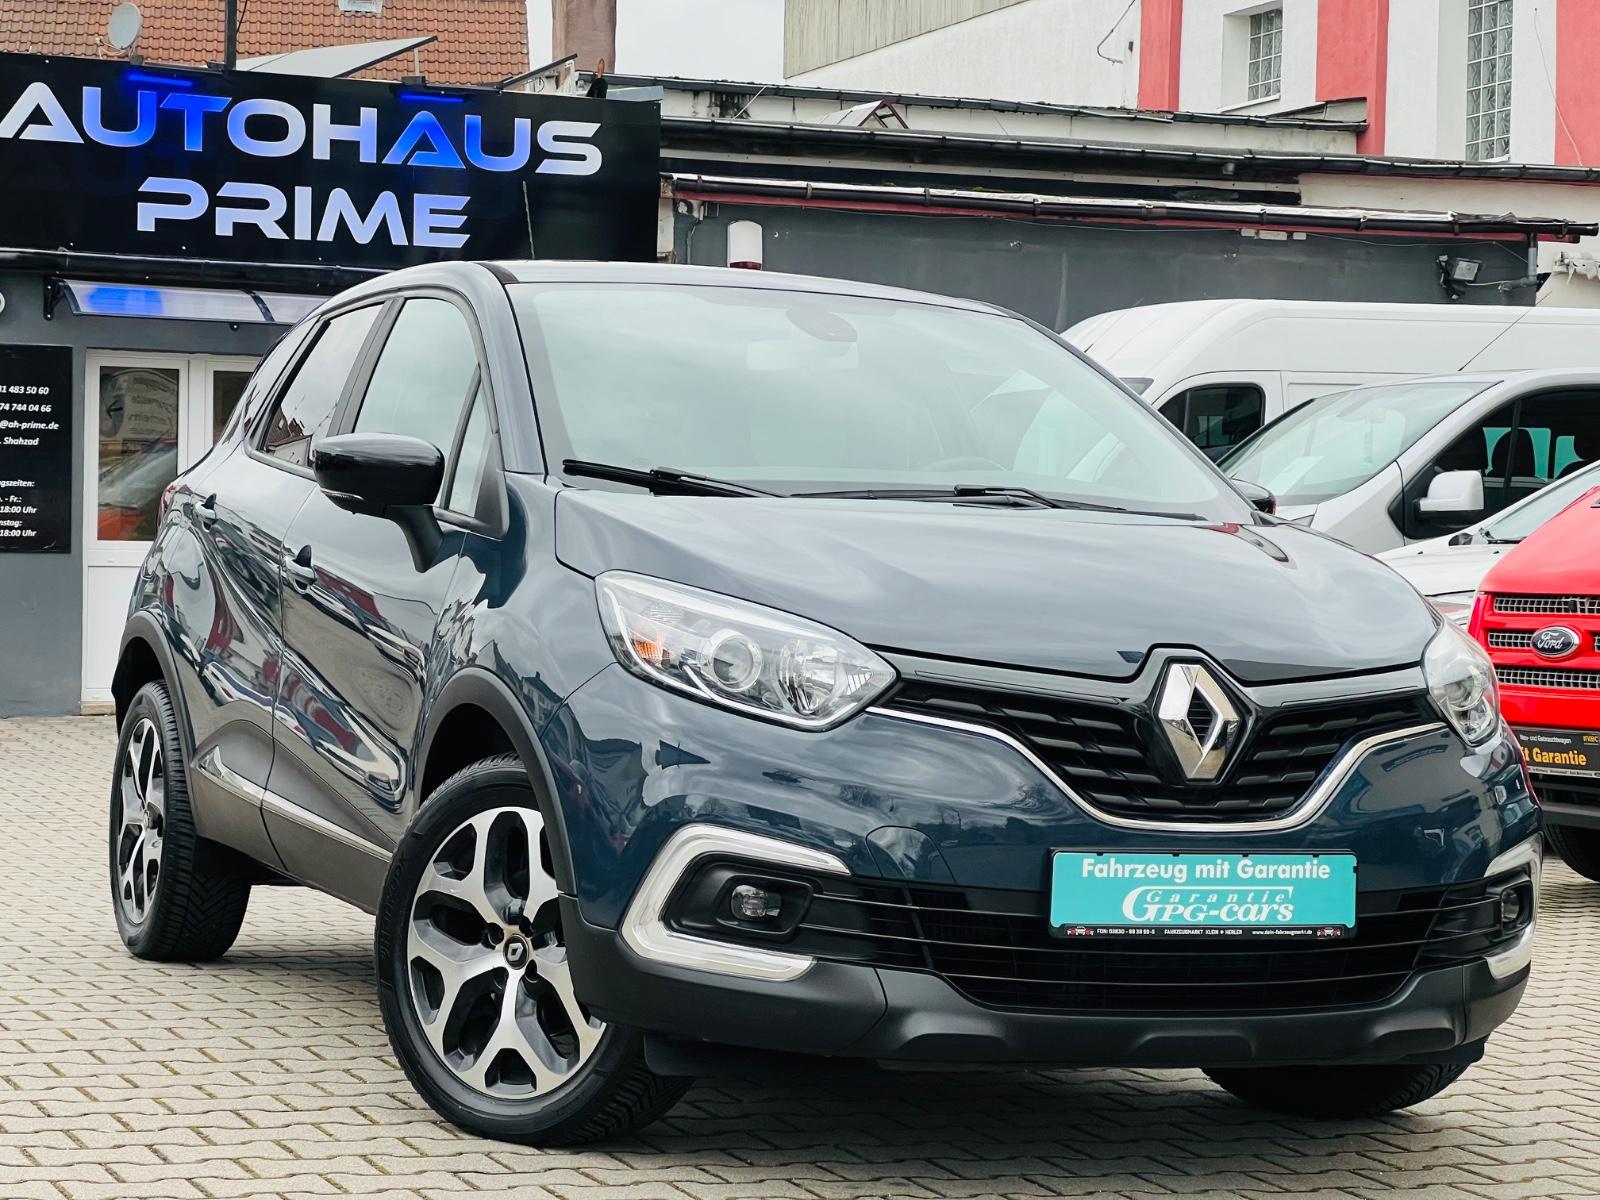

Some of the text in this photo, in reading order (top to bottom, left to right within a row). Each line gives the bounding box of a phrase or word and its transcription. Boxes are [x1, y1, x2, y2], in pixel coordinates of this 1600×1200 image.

[0, 81, 603, 176] AUTOHAUS
[136, 176, 471, 249] PRIME
[8, 385, 25, 394] 483
[26, 386, 37, 394] 50
[38, 386, 50, 395] 60
[11, 403, 27, 412] 744
[28, 404, 39, 412] 04
[40, 404, 52, 413] 66
[3, 436, 40, 446] Shahzad
[0, 505, 38, 513] 18:00 Uhr
[0, 529, 37, 537] 18:00 Uhr
[1537, 631, 1565, 649] Ford
[1532, 747, 1587, 766] Garantie
[1082, 858, 1331, 883] Fahrzeug mit Garantie
[1146, 890, 1286, 903] Garantie
